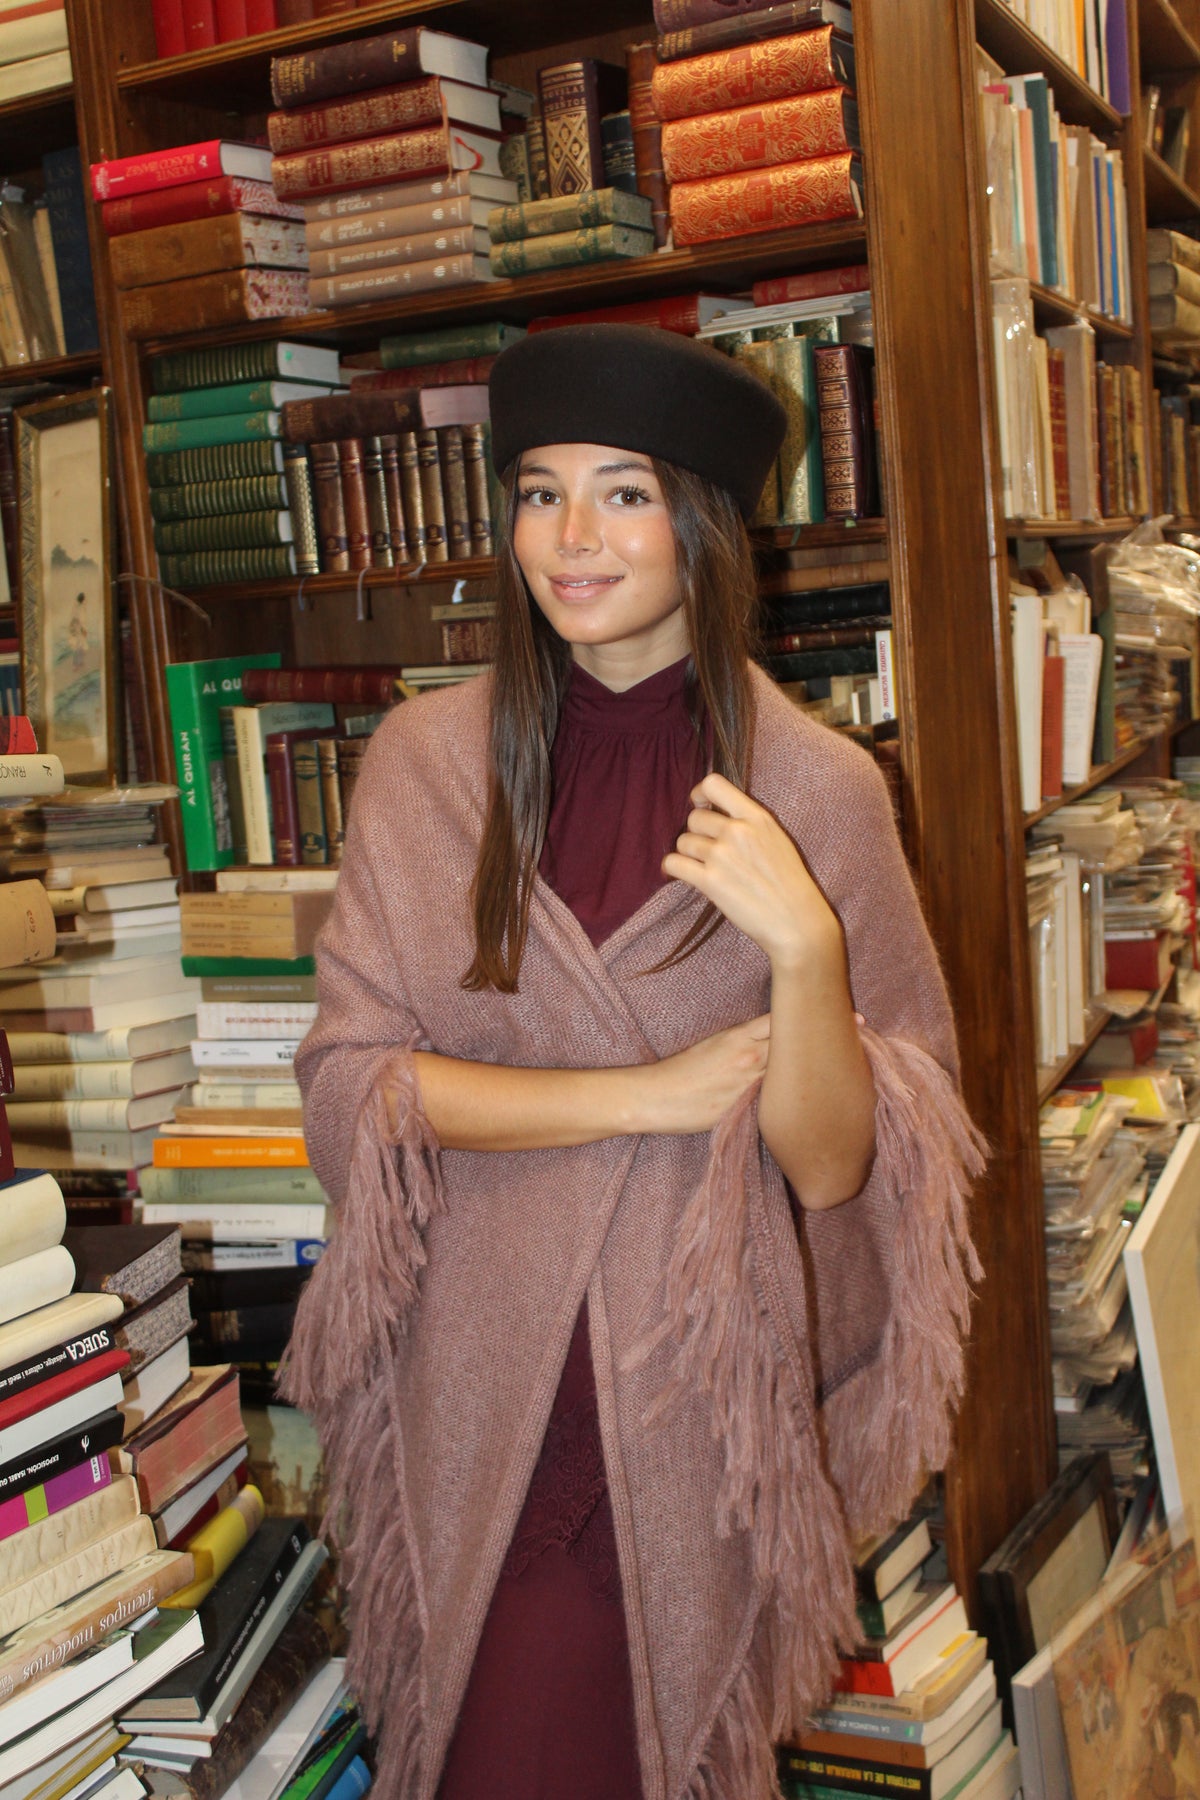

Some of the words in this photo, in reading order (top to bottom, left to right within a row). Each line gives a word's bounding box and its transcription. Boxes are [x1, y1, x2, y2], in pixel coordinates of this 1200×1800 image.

[202, 681, 217, 695] AL
[180, 731, 195, 784] QURAN
[187, 788, 197, 806] AL
[66, 1329, 110, 1361] SUECA
[25, 1363, 44, 1376] cultura
[7, 1374, 22, 1386] medi
[9, 1469, 26, 1483] ISABEL
[99, 1588, 156, 1633] Tiempos
[22, 1625, 94, 1681] modernos
[848, 1721, 880, 1733] VALENCIA
[881, 1725, 891, 1734] LA
[863, 1770, 874, 1782] LA
[874, 1771, 885, 1784] DE
[886, 1773, 922, 1791] HISTORIA
